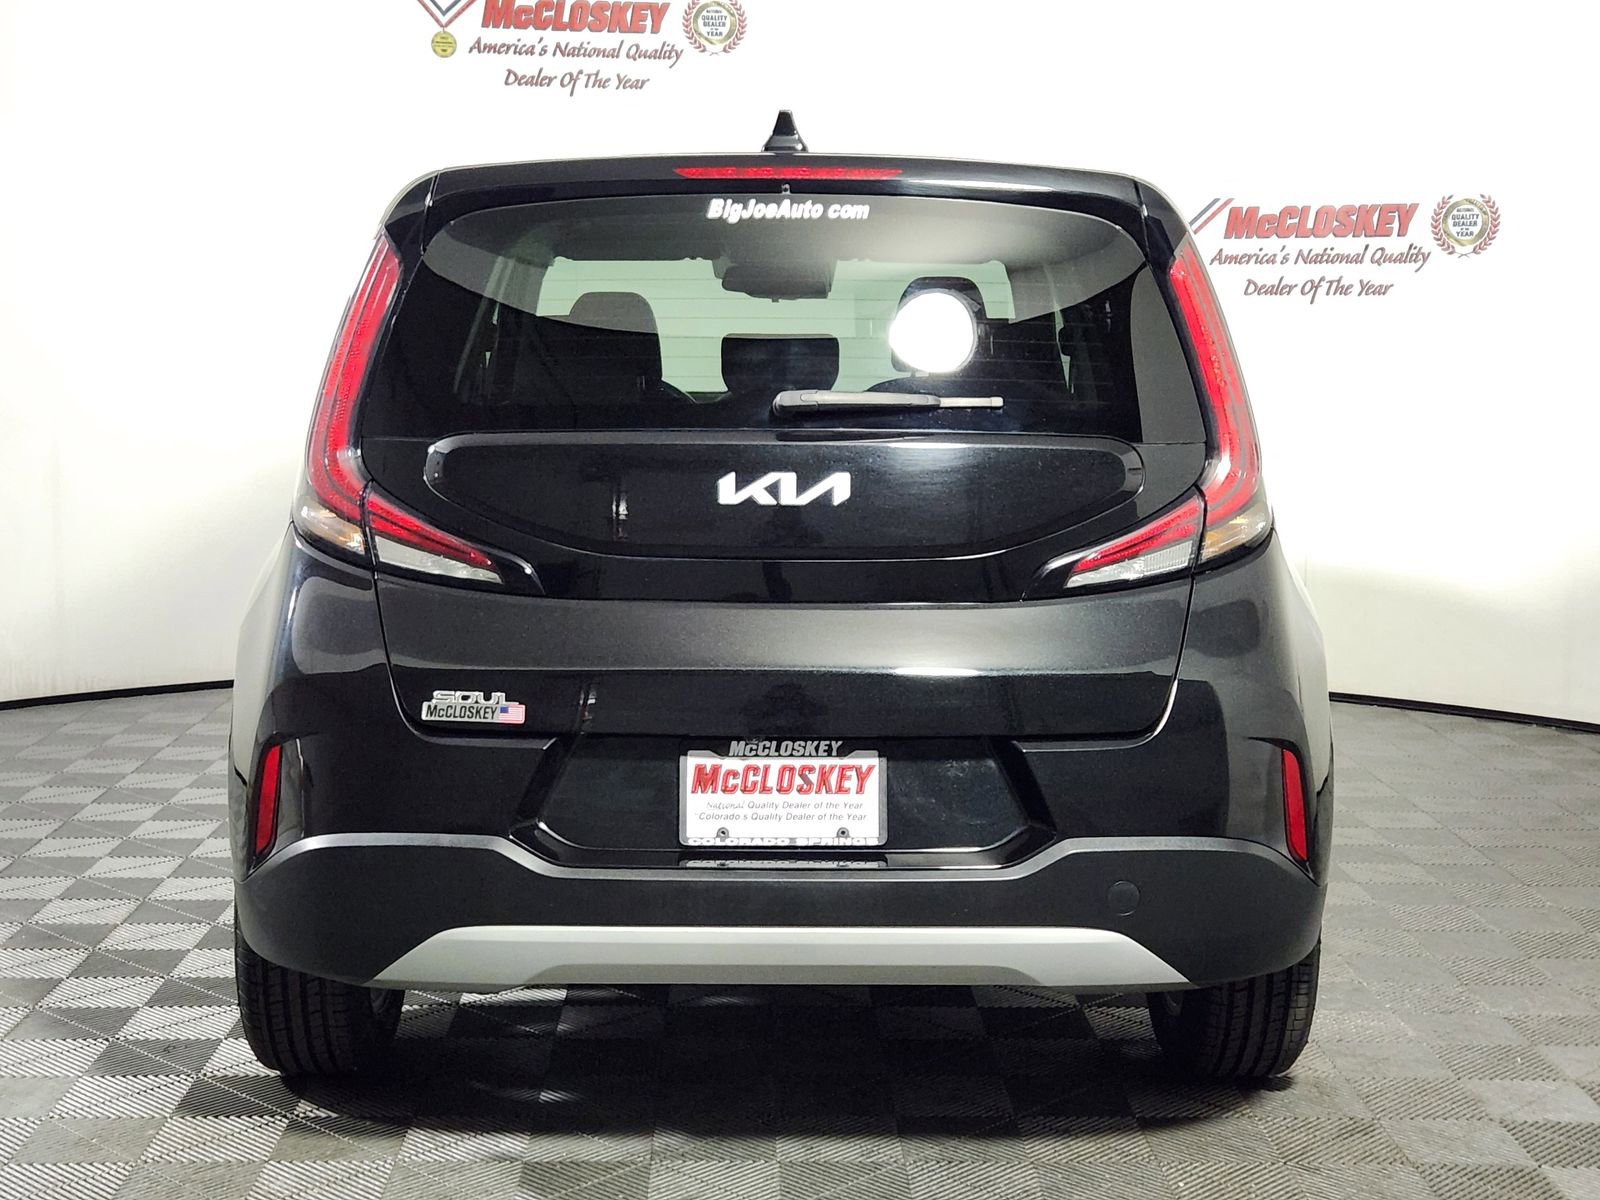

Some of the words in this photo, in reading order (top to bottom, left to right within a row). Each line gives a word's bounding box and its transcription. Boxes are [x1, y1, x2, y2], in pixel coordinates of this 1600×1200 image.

[481, 0, 670, 34] McCLOSKEY
[469, 36, 548, 57] America's
[552, 40, 624, 59] National
[626, 41, 684, 69] Quality
[504, 67, 557, 88] Dealer
[560, 69, 583, 97] Of
[584, 69, 611, 89] The
[615, 73, 650, 90] Year
[1223, 203, 1419, 239] McCLOSKEY
[1209, 245, 1290, 266] America's
[1294, 243, 1369, 265] National
[1370, 243, 1431, 272] Quality
[1243, 276, 1297, 296] Dealer
[1300, 276, 1325, 304] Of
[1326, 276, 1353, 296] The
[1357, 279, 1394, 297] Year
[717, 471, 851, 506] KIA
[432, 690, 520, 704] SOUL
[425, 704, 498, 720] McCLOSKEY
[728, 740, 843, 757] McCLOSKEY
[691, 763, 876, 795] McCLOSKEY
[747, 801, 779, 811] Quality
[782, 801, 811, 809] Dealer
[814, 801, 823, 809] of
[825, 801, 840, 809] the
[751, 812, 783, 823] Quality
[785, 813, 815, 821] Dealer
[817, 813, 827, 821] of
[829, 813, 844, 821] the
[847, 813, 867, 821] Year
